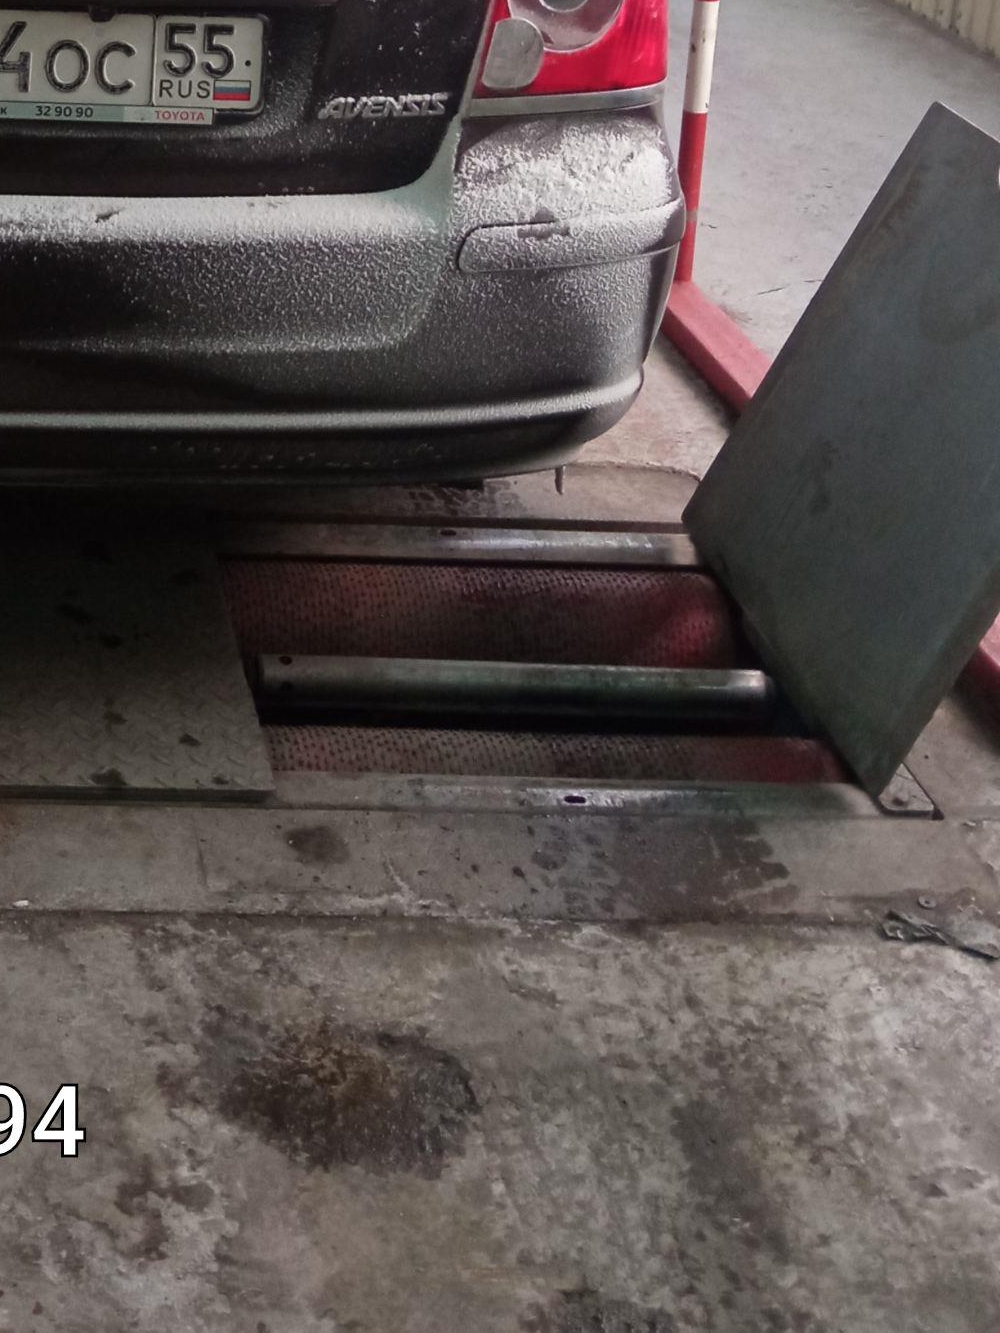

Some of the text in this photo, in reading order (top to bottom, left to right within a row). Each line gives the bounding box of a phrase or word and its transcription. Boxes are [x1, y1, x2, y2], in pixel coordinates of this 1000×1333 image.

[163, 22, 236, 79] 55
[159, 80, 211, 100] RUS
[35, 104, 52, 117] 32
[54, 105, 73, 118] 90
[75, 106, 94, 119] 90
[154, 109, 205, 122] TOYOTA
[318, 92, 449, 119] AVENSIS
